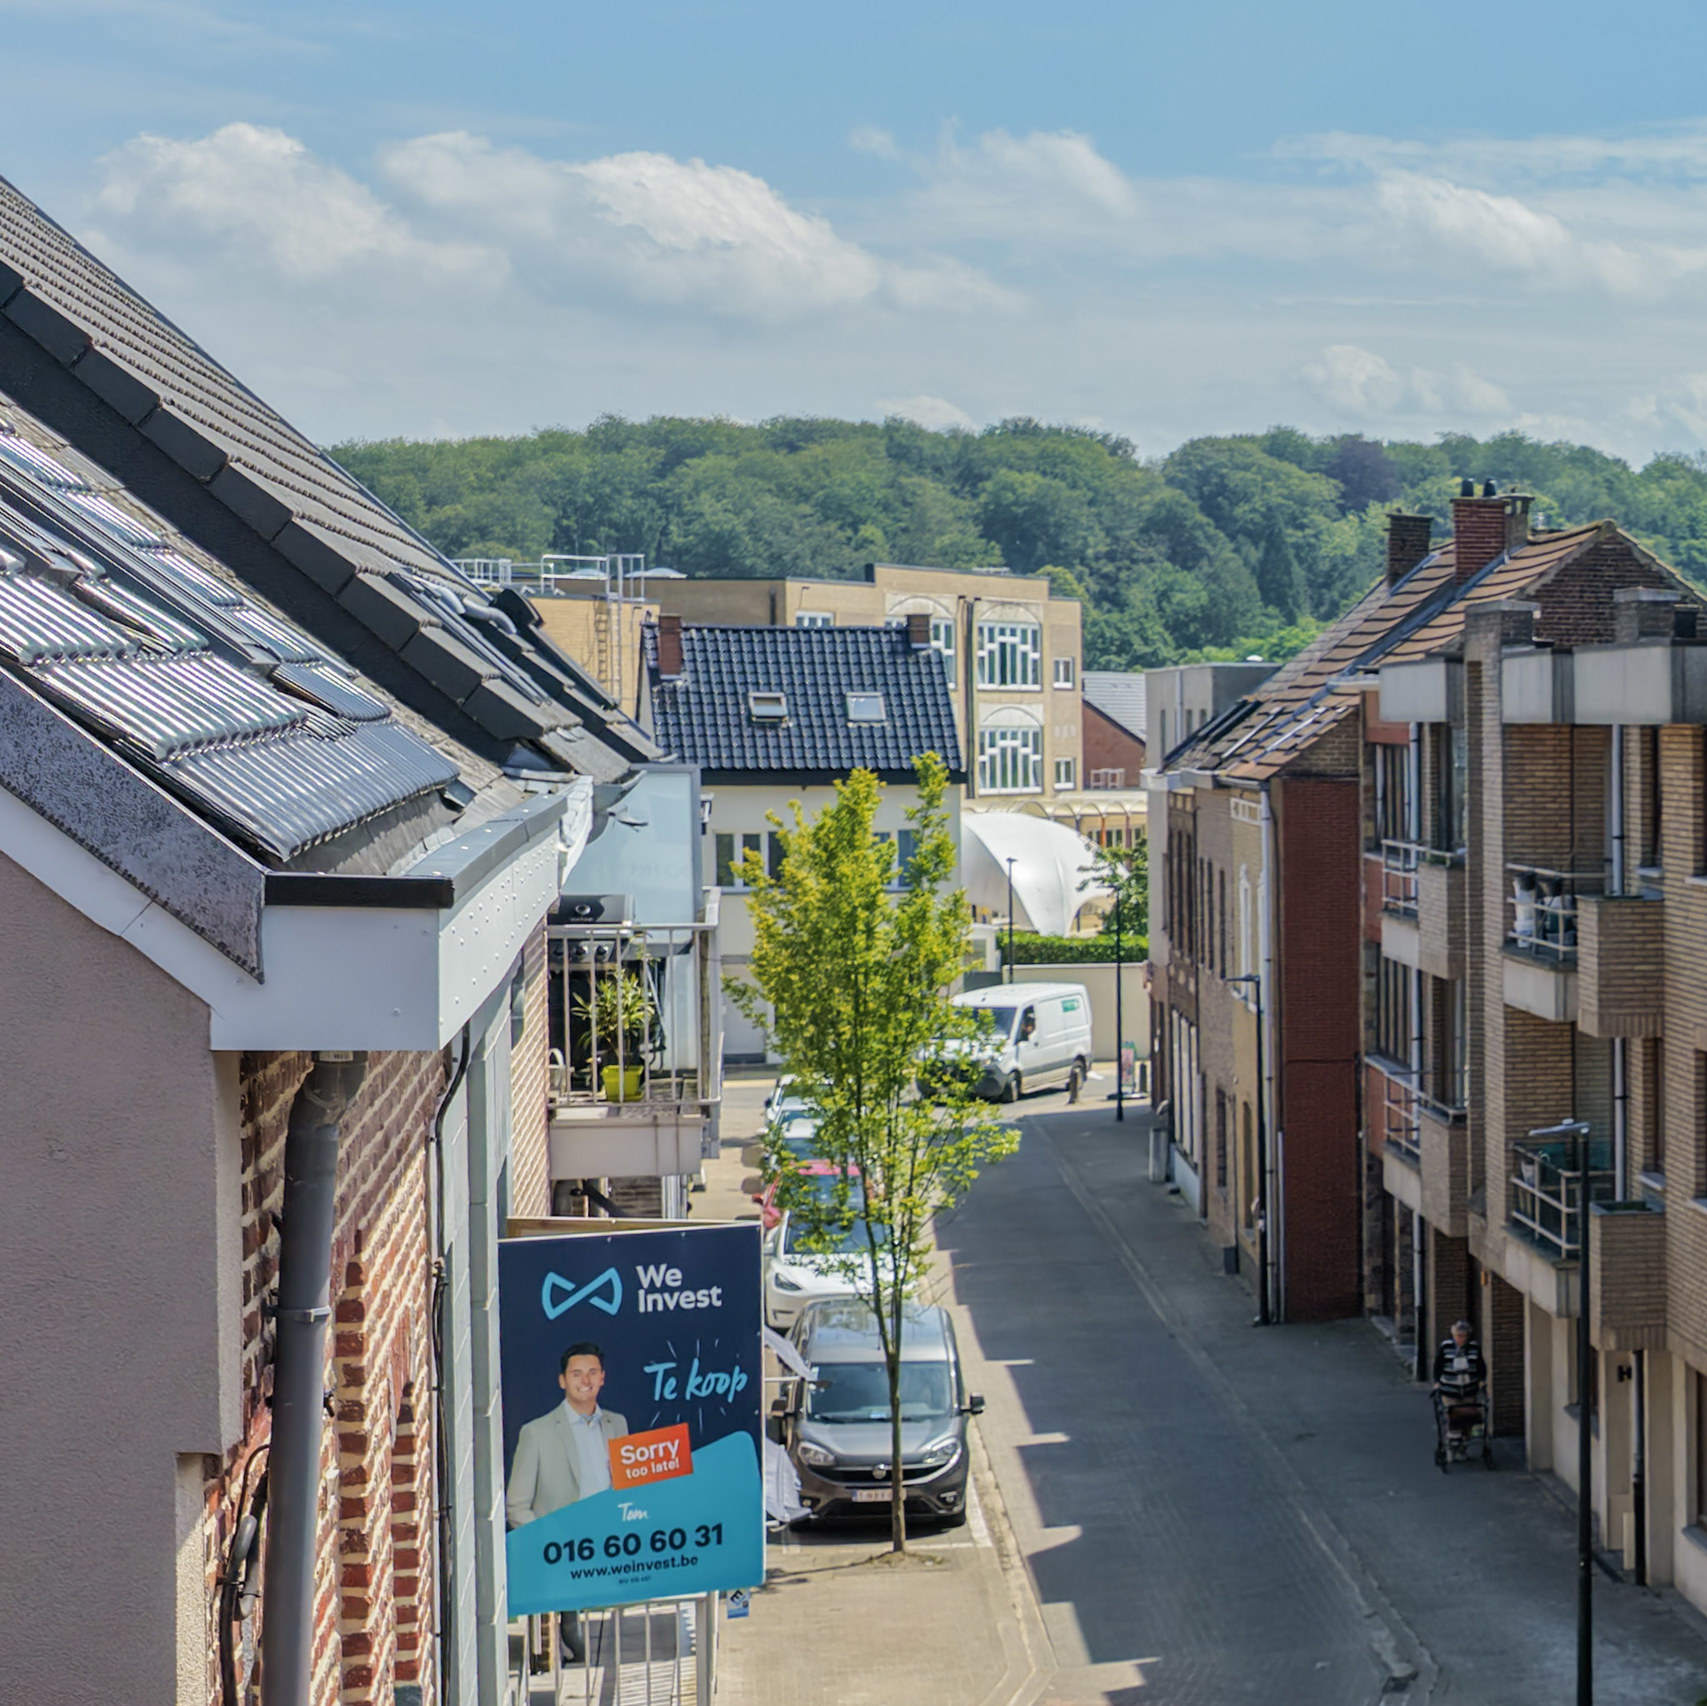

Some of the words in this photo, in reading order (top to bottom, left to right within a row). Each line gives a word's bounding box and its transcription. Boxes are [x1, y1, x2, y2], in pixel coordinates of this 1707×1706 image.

[636, 1264, 682, 1288] We
[637, 1286, 722, 1313] Invest
[644, 1360, 678, 1401] Te
[685, 1357, 748, 1404] koop
[621, 1439, 680, 1466] Sorry
[626, 1465, 648, 1479] too
[651, 1457, 680, 1475] late!
[544, 1538, 595, 1564] 016
[604, 1531, 642, 1559] 60
[650, 1528, 687, 1555] 60
[694, 1523, 724, 1548] 31
[570, 1555, 698, 1580] www.weinvest.be
